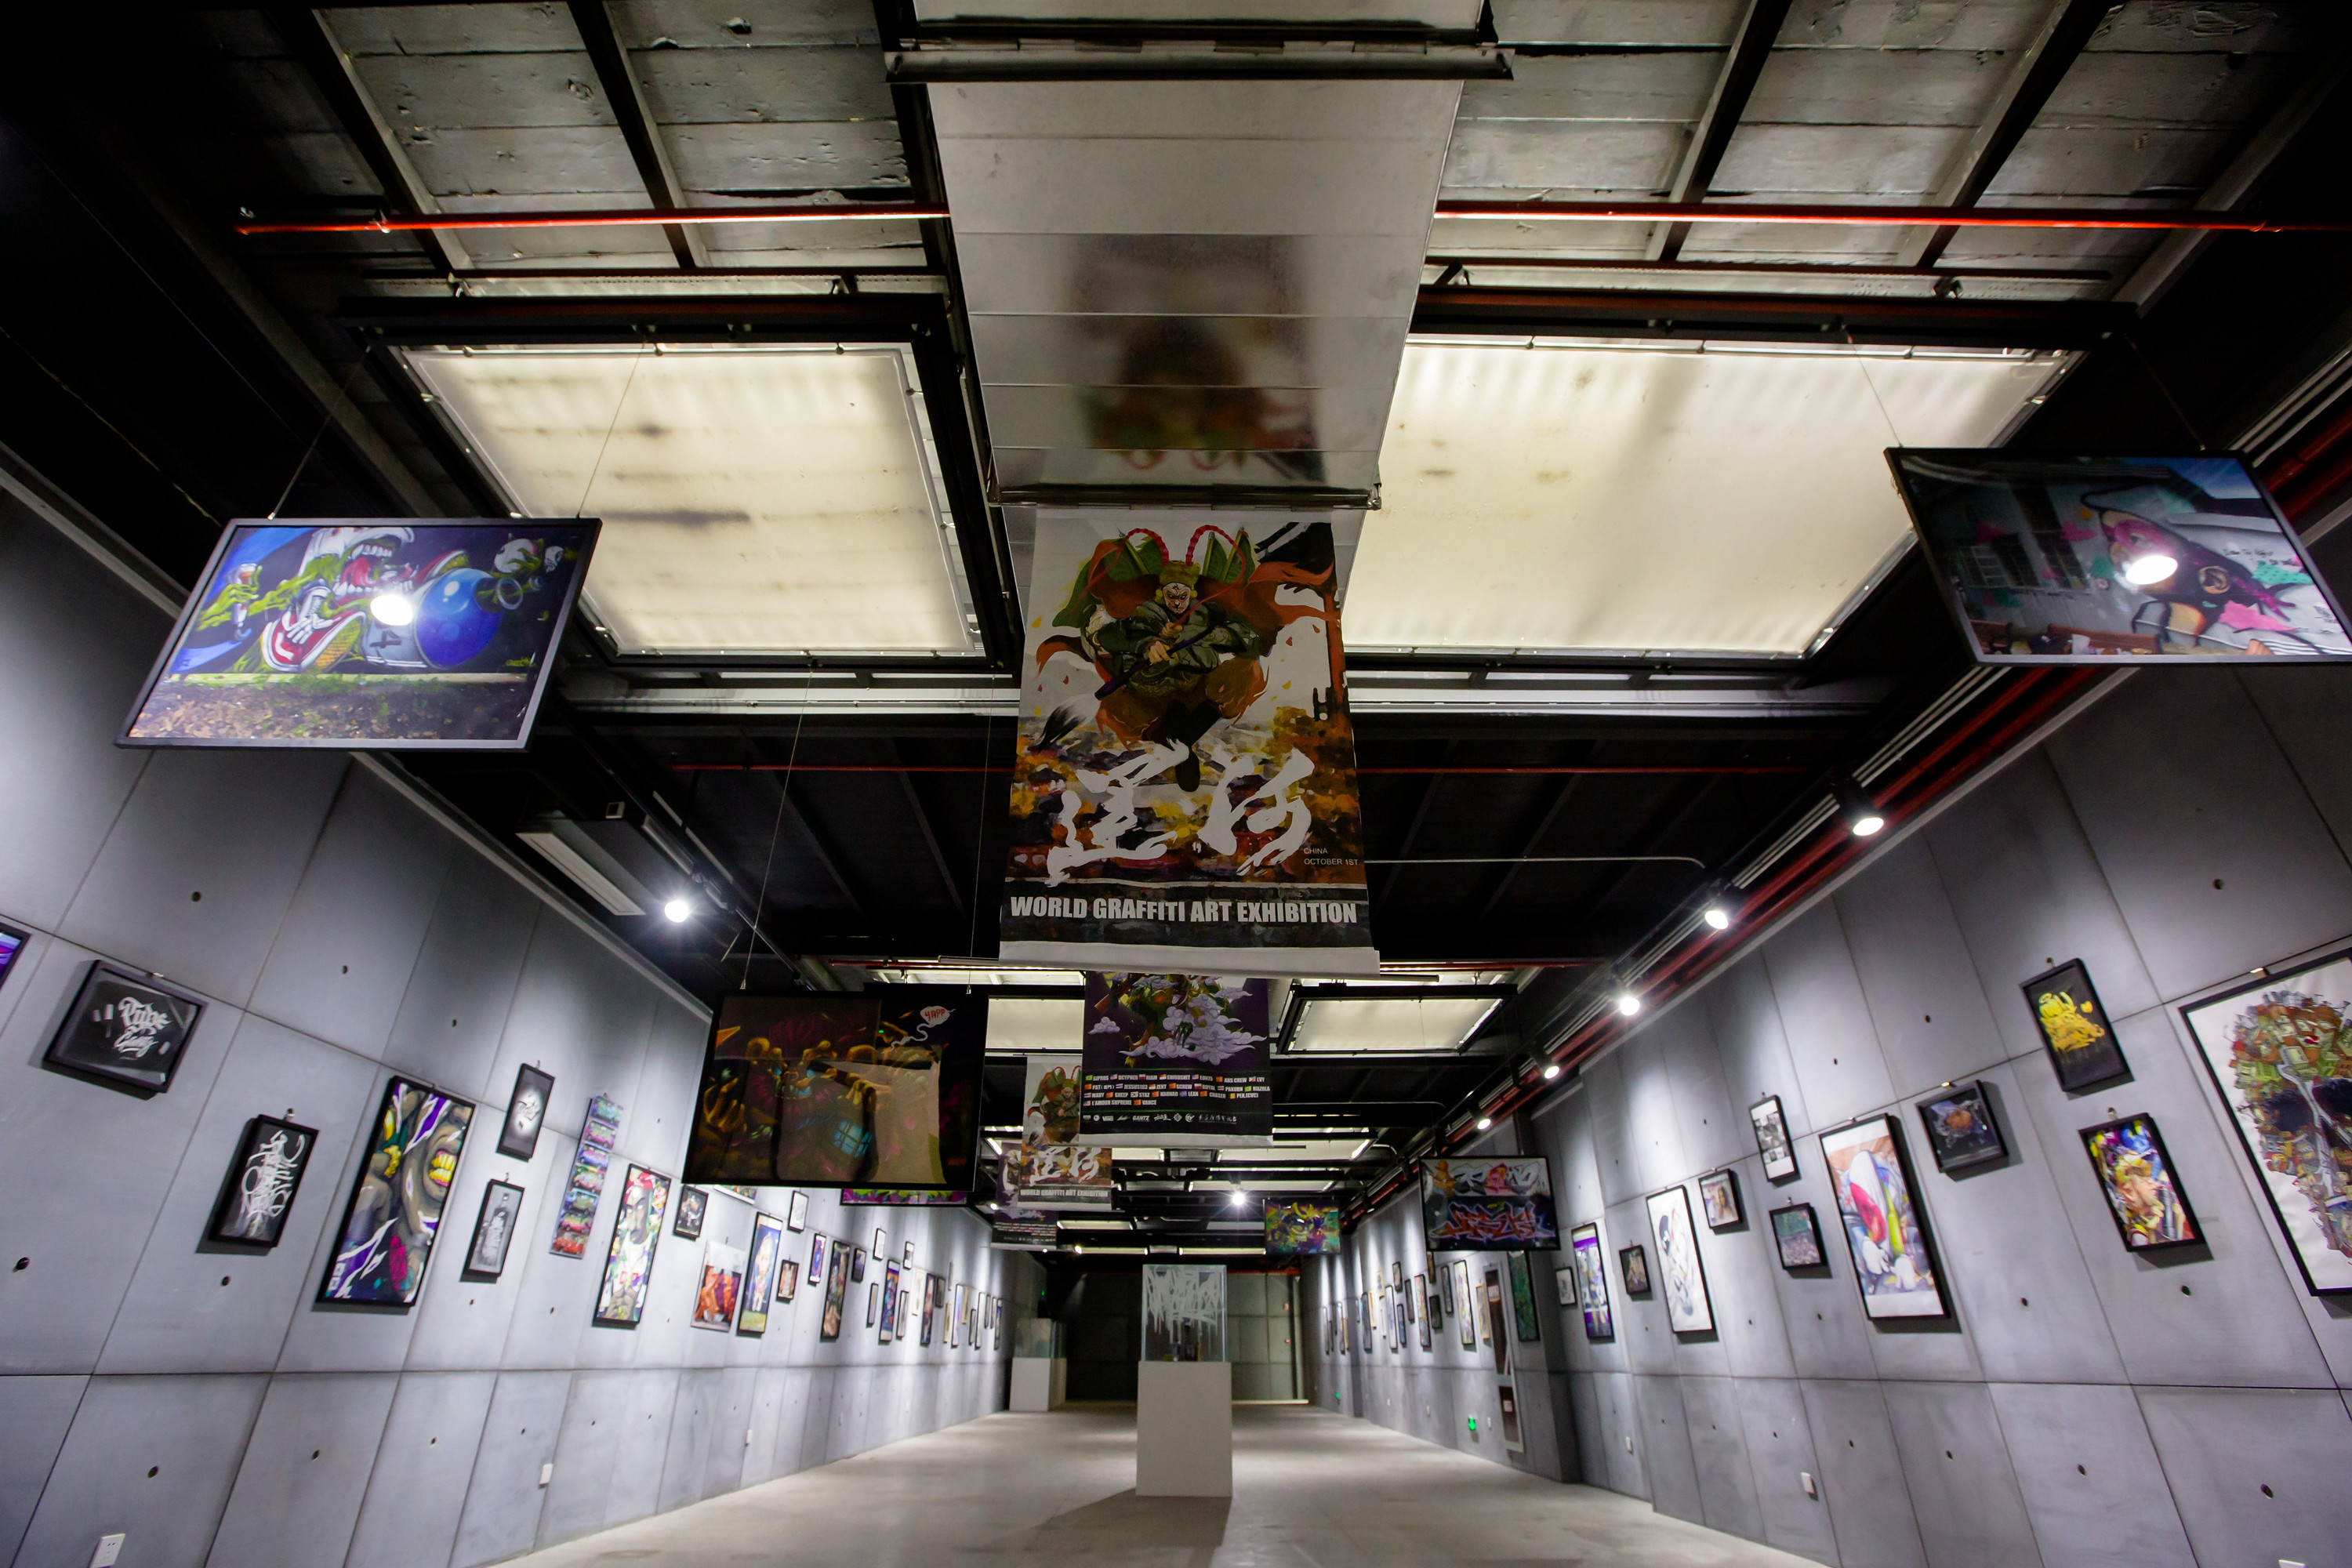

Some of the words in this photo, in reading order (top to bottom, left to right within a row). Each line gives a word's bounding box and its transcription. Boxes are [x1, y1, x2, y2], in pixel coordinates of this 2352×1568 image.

[1010, 896, 1087, 919] WORLD
[1093, 898, 1185, 922] GRAFFITI
[1190, 901, 1232, 923] ART
[1237, 902, 1357, 924] EXHIBITION
